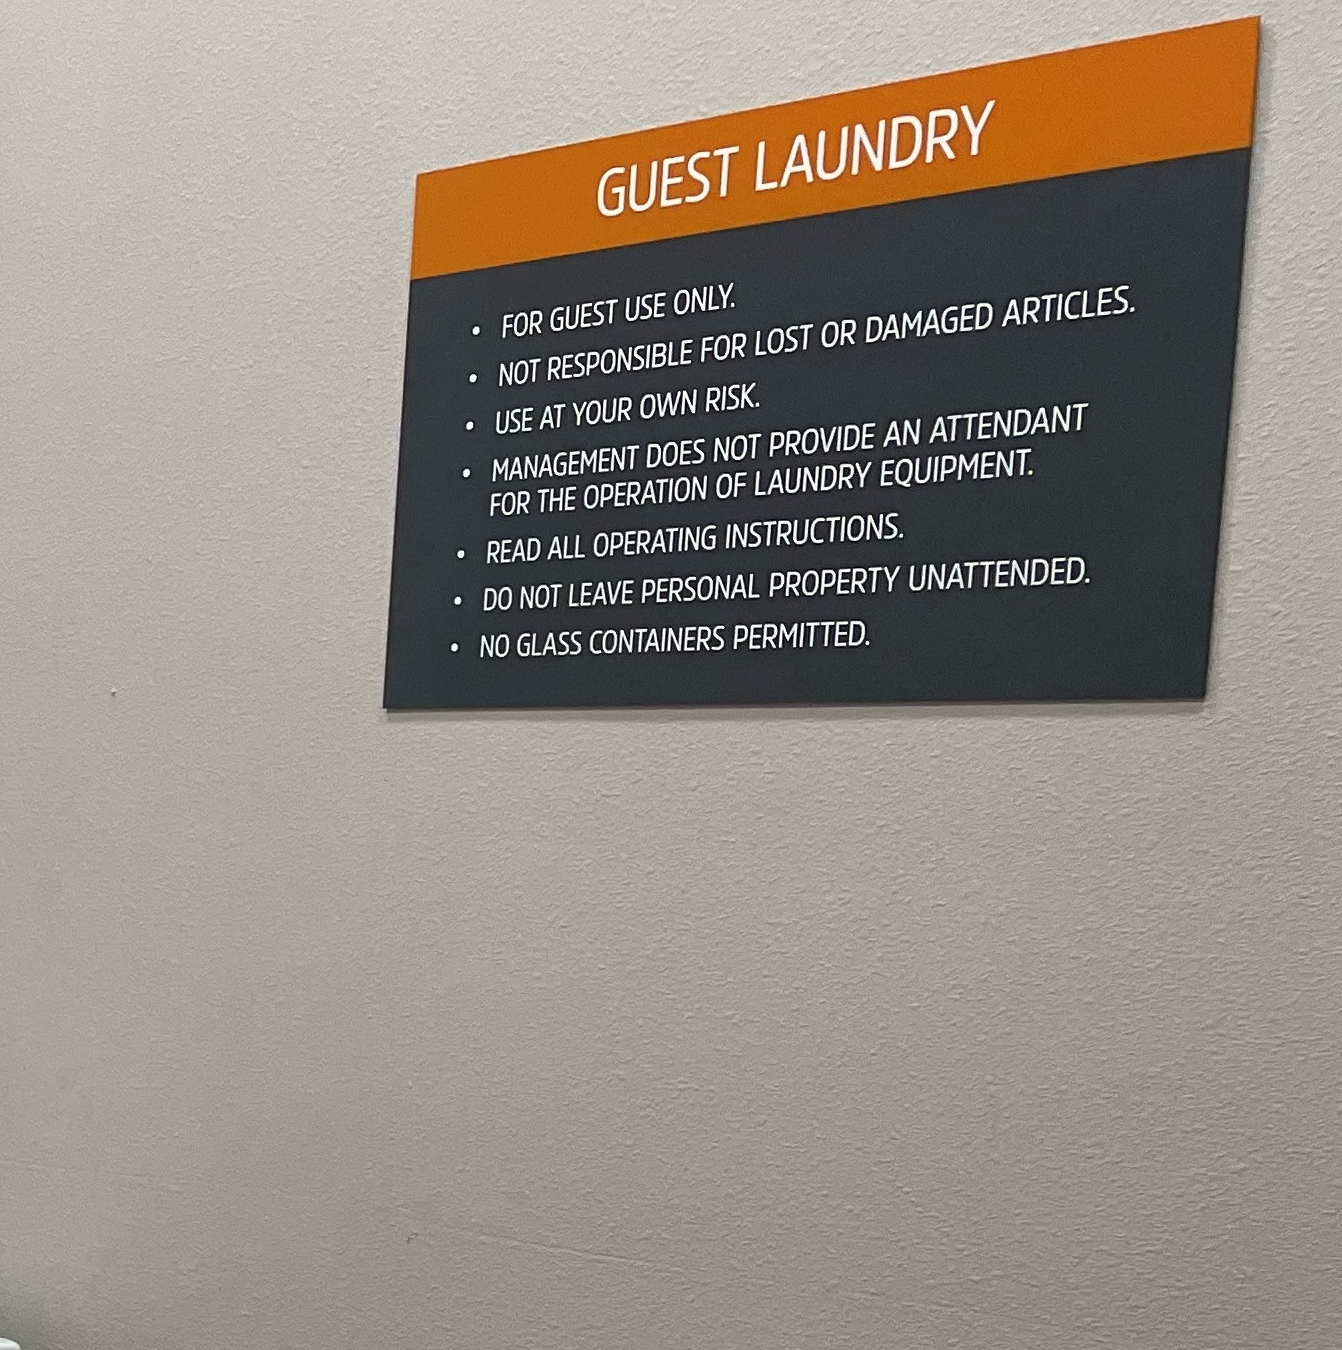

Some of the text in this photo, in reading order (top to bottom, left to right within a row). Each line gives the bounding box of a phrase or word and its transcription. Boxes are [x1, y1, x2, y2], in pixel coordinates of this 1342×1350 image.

[597, 99, 996, 217] GUEST LAUNDRY
[498, 285, 1136, 387] NOT RESPONSIBLE FOR LOST OR DAMAGED ARTICLES.
[501, 282, 736, 339] FOR GUEST USE ONLY.
[495, 382, 760, 435] USE AT YOUR OWN RISK.
[491, 402, 1090, 483] MANAGEMENT DOES NOT PROVIDE AN ATTENDANT
[489, 448, 1034, 517] FOR THE OPERATION OF LAUNDRY EQUIPMENT.
[486, 512, 904, 564] READ ALL OPERATING INSTRUCTIONS.
[483, 556, 1091, 612] DO NOT LEAVE PERSONAL PROPERTY UNATTENDED.
[479, 620, 870, 658] NO GLASS CONTAINERS PERMITTED.
